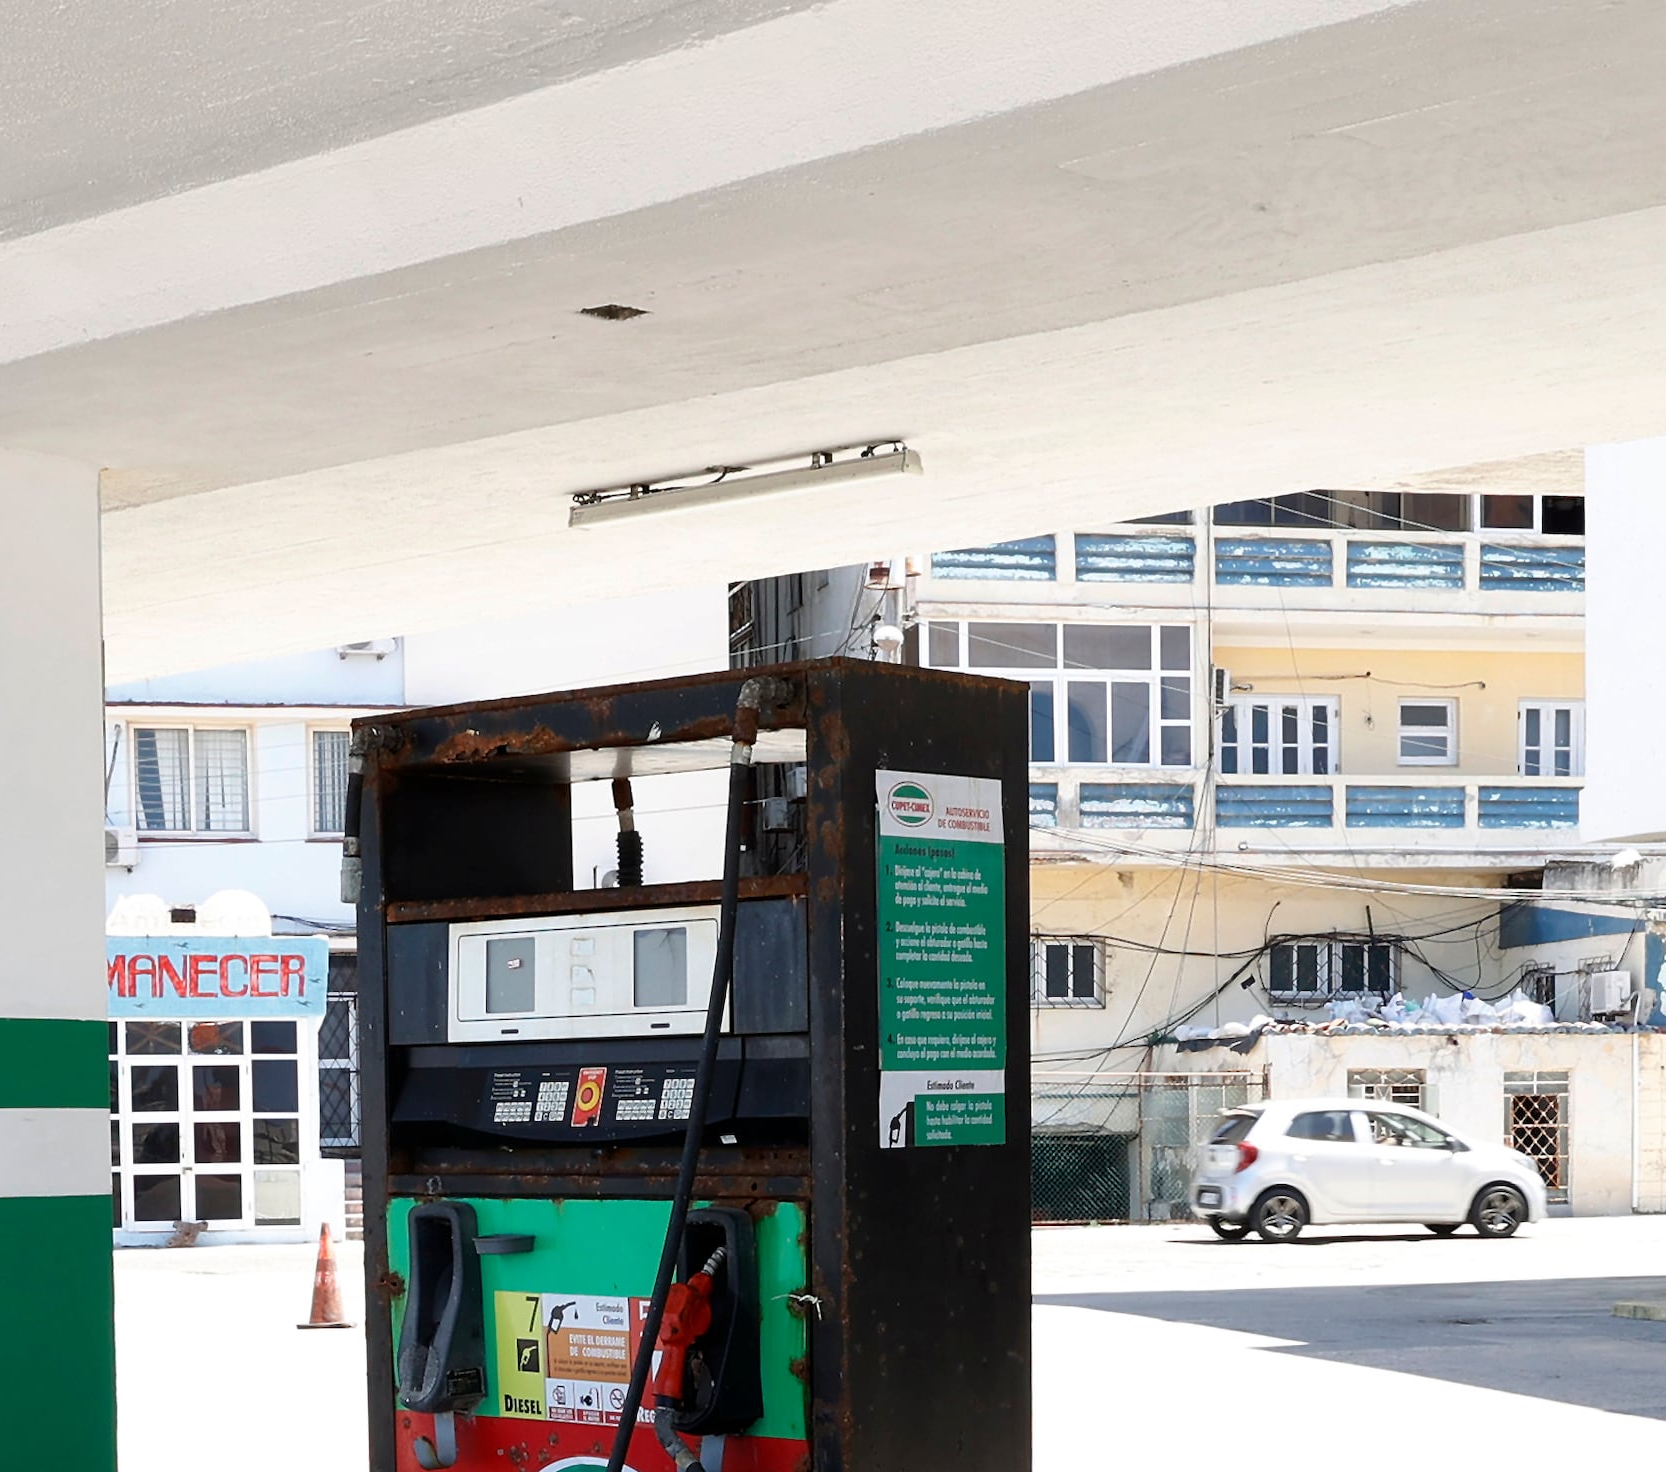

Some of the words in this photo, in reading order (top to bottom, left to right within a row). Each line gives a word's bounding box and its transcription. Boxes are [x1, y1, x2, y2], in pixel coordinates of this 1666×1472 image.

[892, 801, 930, 813] CUPET-CIMEX
[946, 807, 989, 819] AUTOSERVICIO
[938, 819, 947, 829] DE
[948, 820, 990, 832] COMBUSTIBLE
[895, 844, 926, 857] Acciones
[927, 1080, 953, 1090] Estimado
[955, 1080, 974, 1090] Cliente
[526, 1297, 540, 1332] 7
[596, 1303, 623, 1313] Estimado
[603, 1315, 624, 1325] Cliente
[569, 1334, 587, 1344] EVITE
[588, 1335, 595, 1345] EL
[596, 1335, 625, 1347] DERRAME
[570, 1346, 578, 1356] DE
[582, 1347, 626, 1359] COMBUSTIBLE
[504, 1394, 542, 1415] DIESEL
